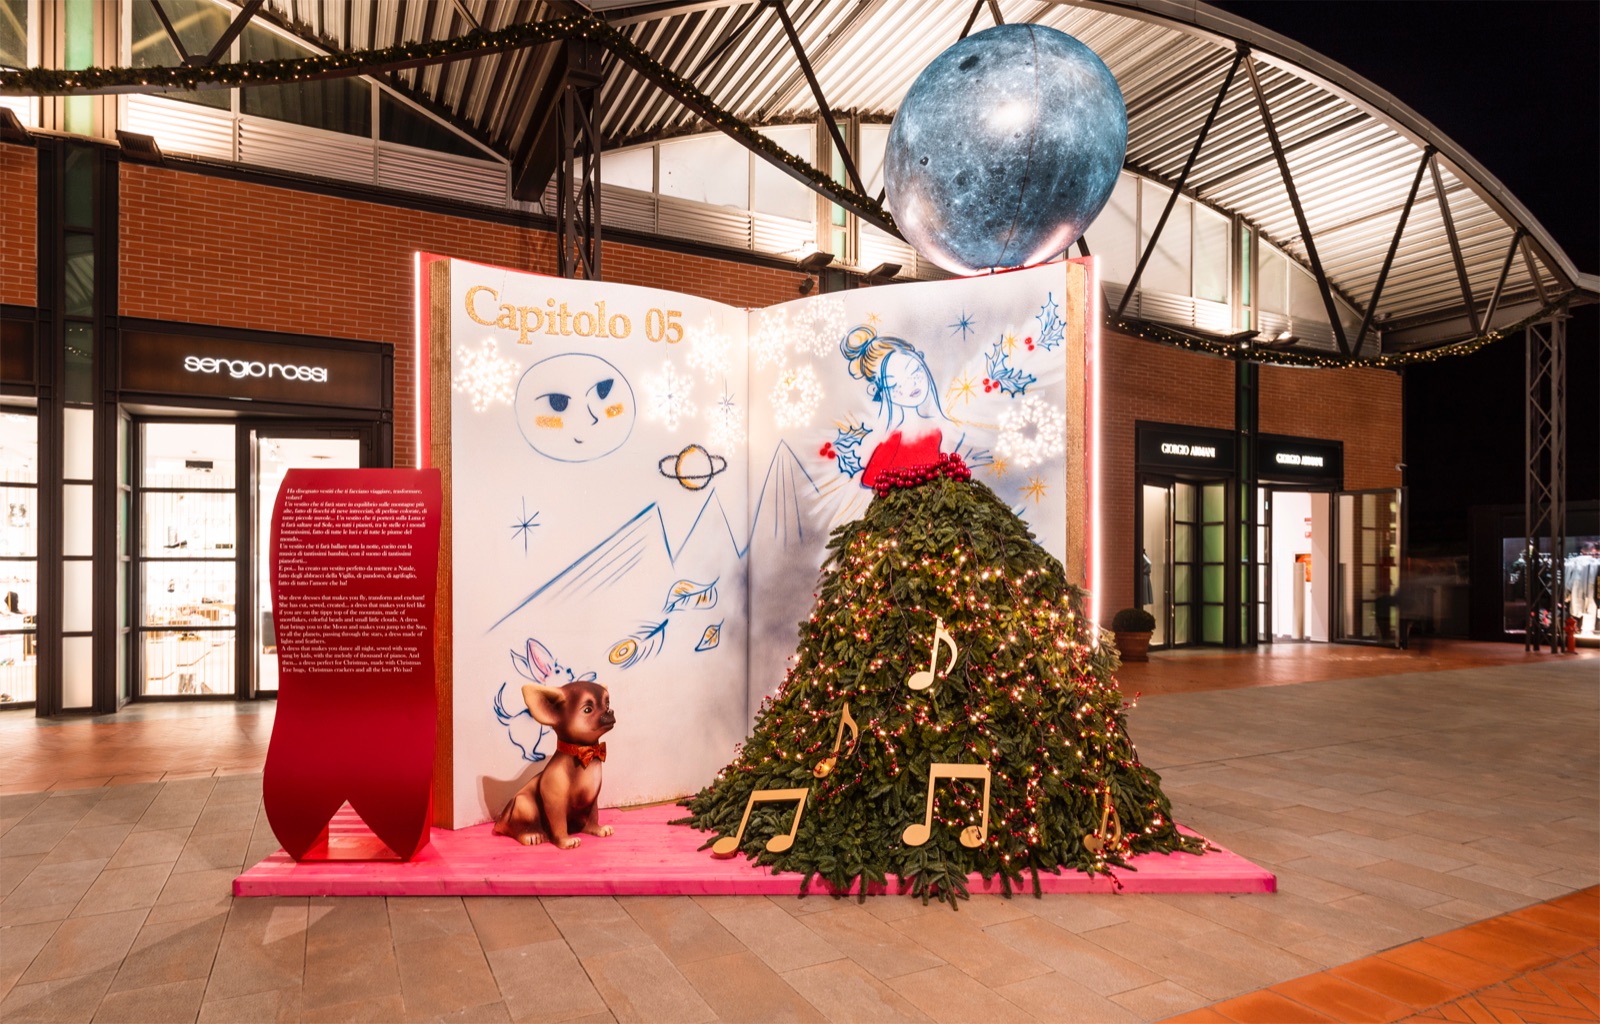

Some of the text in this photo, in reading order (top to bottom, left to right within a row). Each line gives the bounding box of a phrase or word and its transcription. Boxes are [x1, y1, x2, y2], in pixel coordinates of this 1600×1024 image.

[465, 285, 684, 345] Capitolo 05
[184, 356, 327, 382] sergio rossi
[1161, 443, 1216, 458] GIORGIO ARMANI
